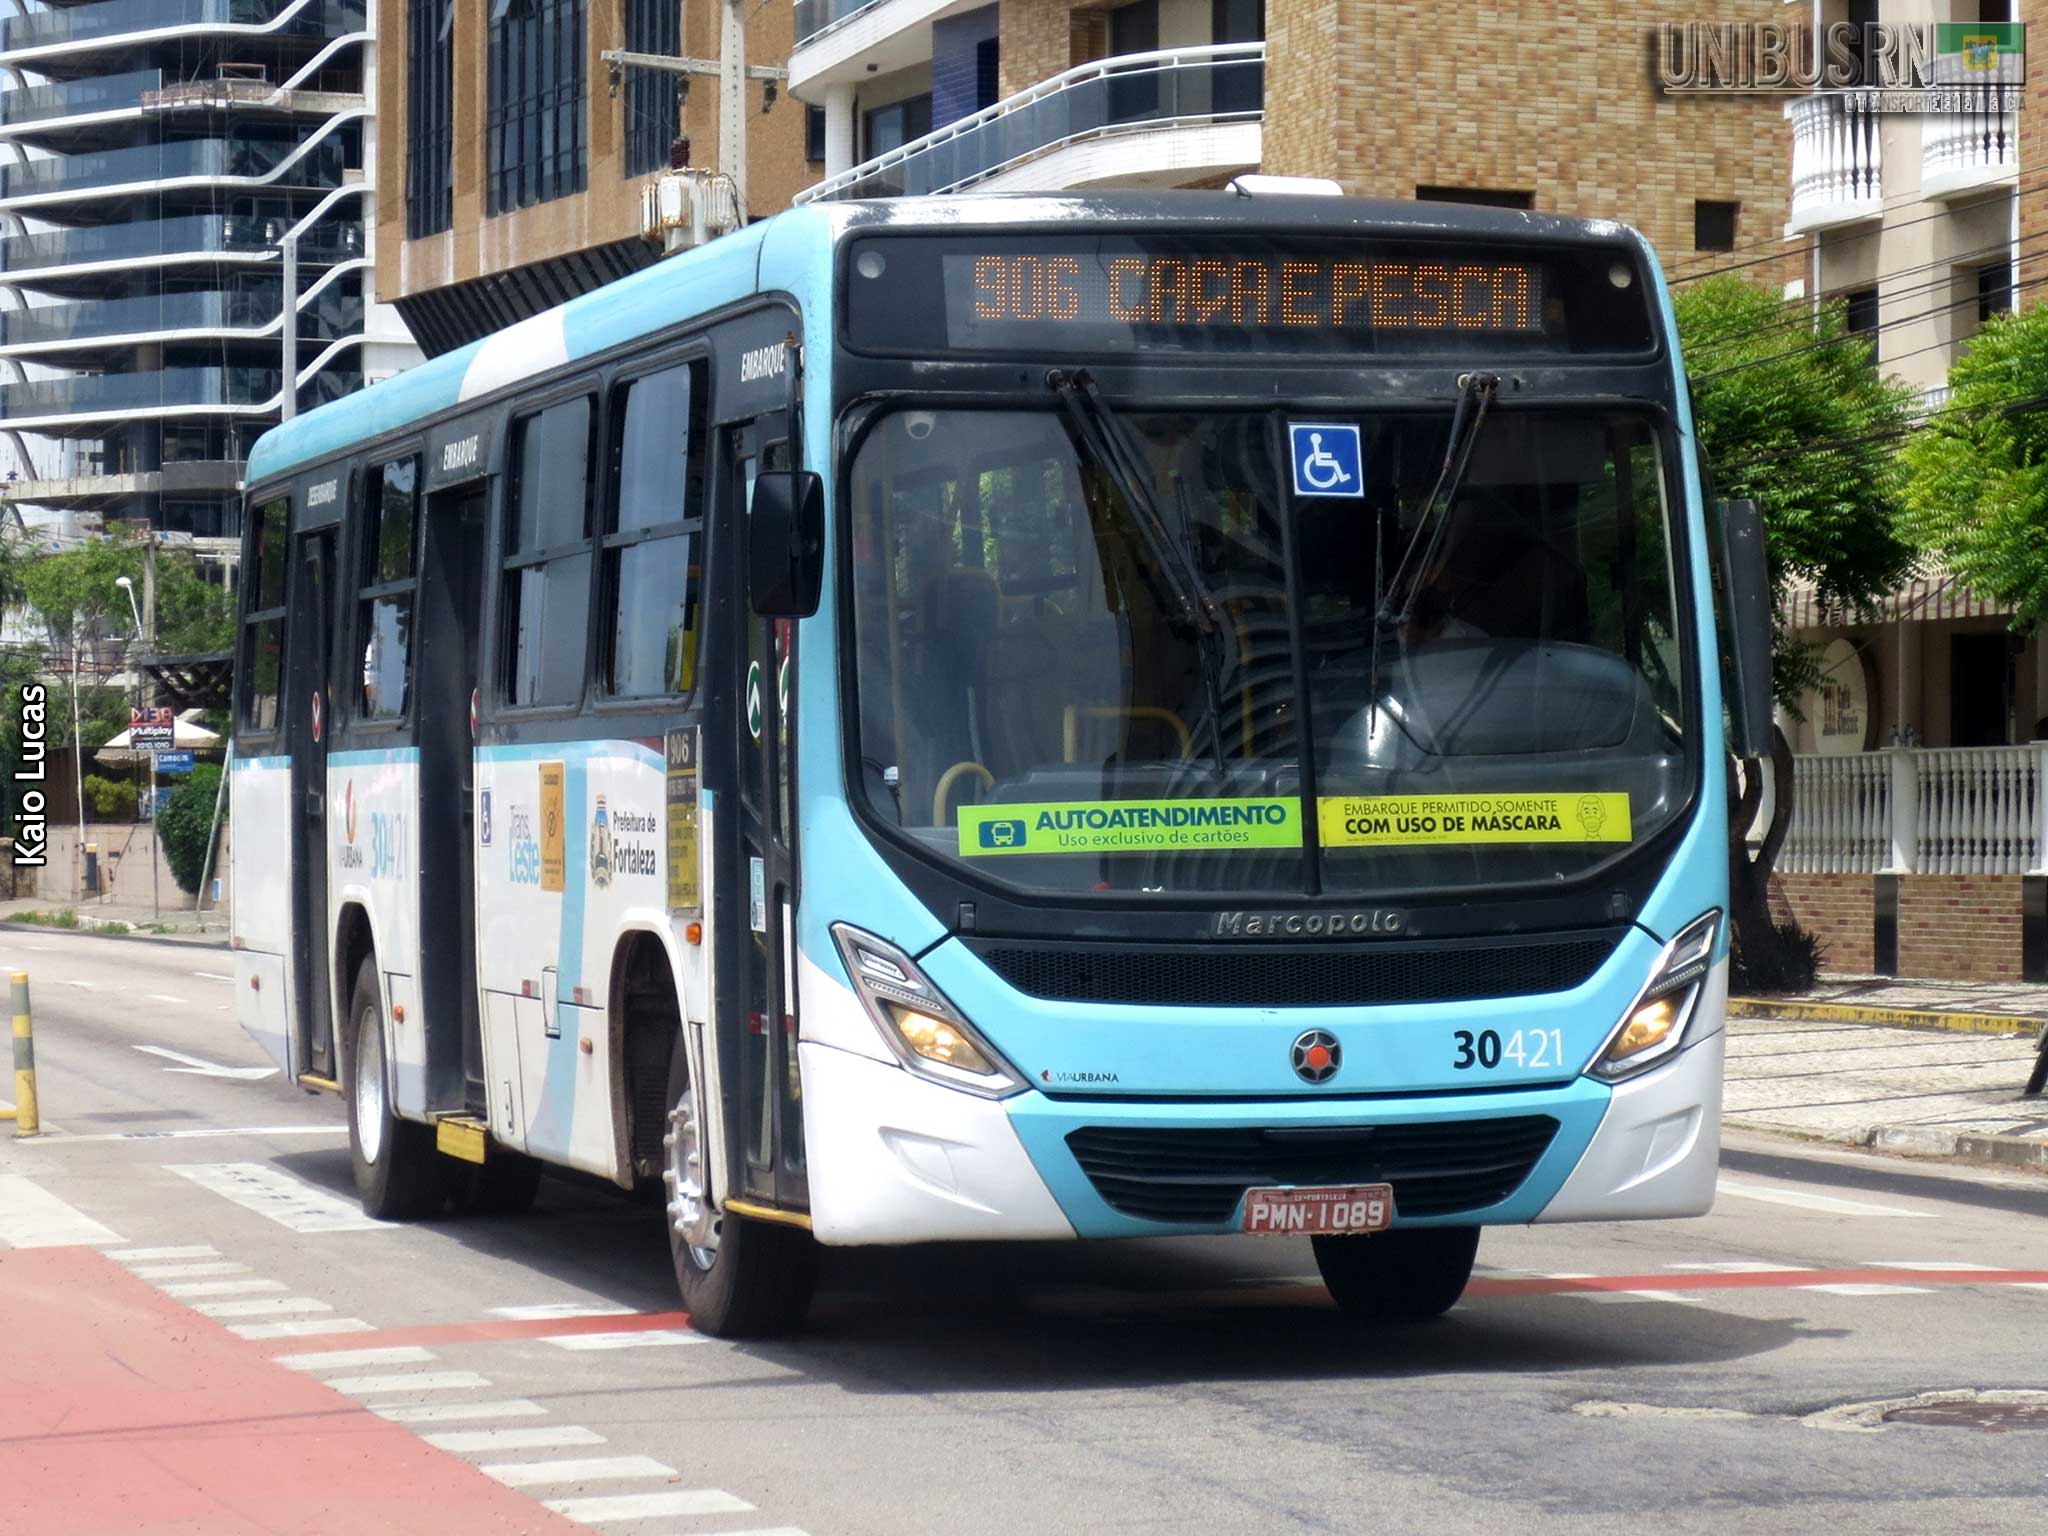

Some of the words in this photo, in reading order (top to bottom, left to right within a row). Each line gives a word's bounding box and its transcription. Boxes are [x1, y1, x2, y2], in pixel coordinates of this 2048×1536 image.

[974, 255, 1080, 321] 906
[1109, 258, 1268, 324] CAÇA
[1282, 262, 1319, 325] E
[1333, 263, 1528, 329] PESCA
[741, 342, 785, 382] EMBARQUE
[442, 434, 478, 471] EMBARQUE
[130, 726, 173, 737] Multiplay
[670, 734, 689, 765] 906
[1035, 803, 1288, 831] AUTOATENDIMENTO
[1344, 802, 1418, 816] EMBARQUE
[1421, 801, 1491, 815] PERMITIDO
[1496, 799, 1558, 813] SOMENTE
[613, 811, 646, 832] Prefeitura
[647, 815, 656, 833] de
[1344, 818, 1391, 835] COM
[1396, 816, 1436, 833] USO
[1443, 816, 1466, 832] DE
[1471, 811, 1562, 832] MÁSCARA
[1058, 833, 1088, 846] Uso
[1092, 830, 1166, 845] exclusivo
[1167, 830, 1189, 843] de
[1192, 829, 1250, 843] cartões
[509, 837, 540, 886] Leste
[613, 838, 656, 876] Fortaleza
[1215, 910, 1402, 936] Marcopolo
[1452, 1029, 1564, 1070] 30421
[1056, 1072, 1120, 1083] VIAURBANA
